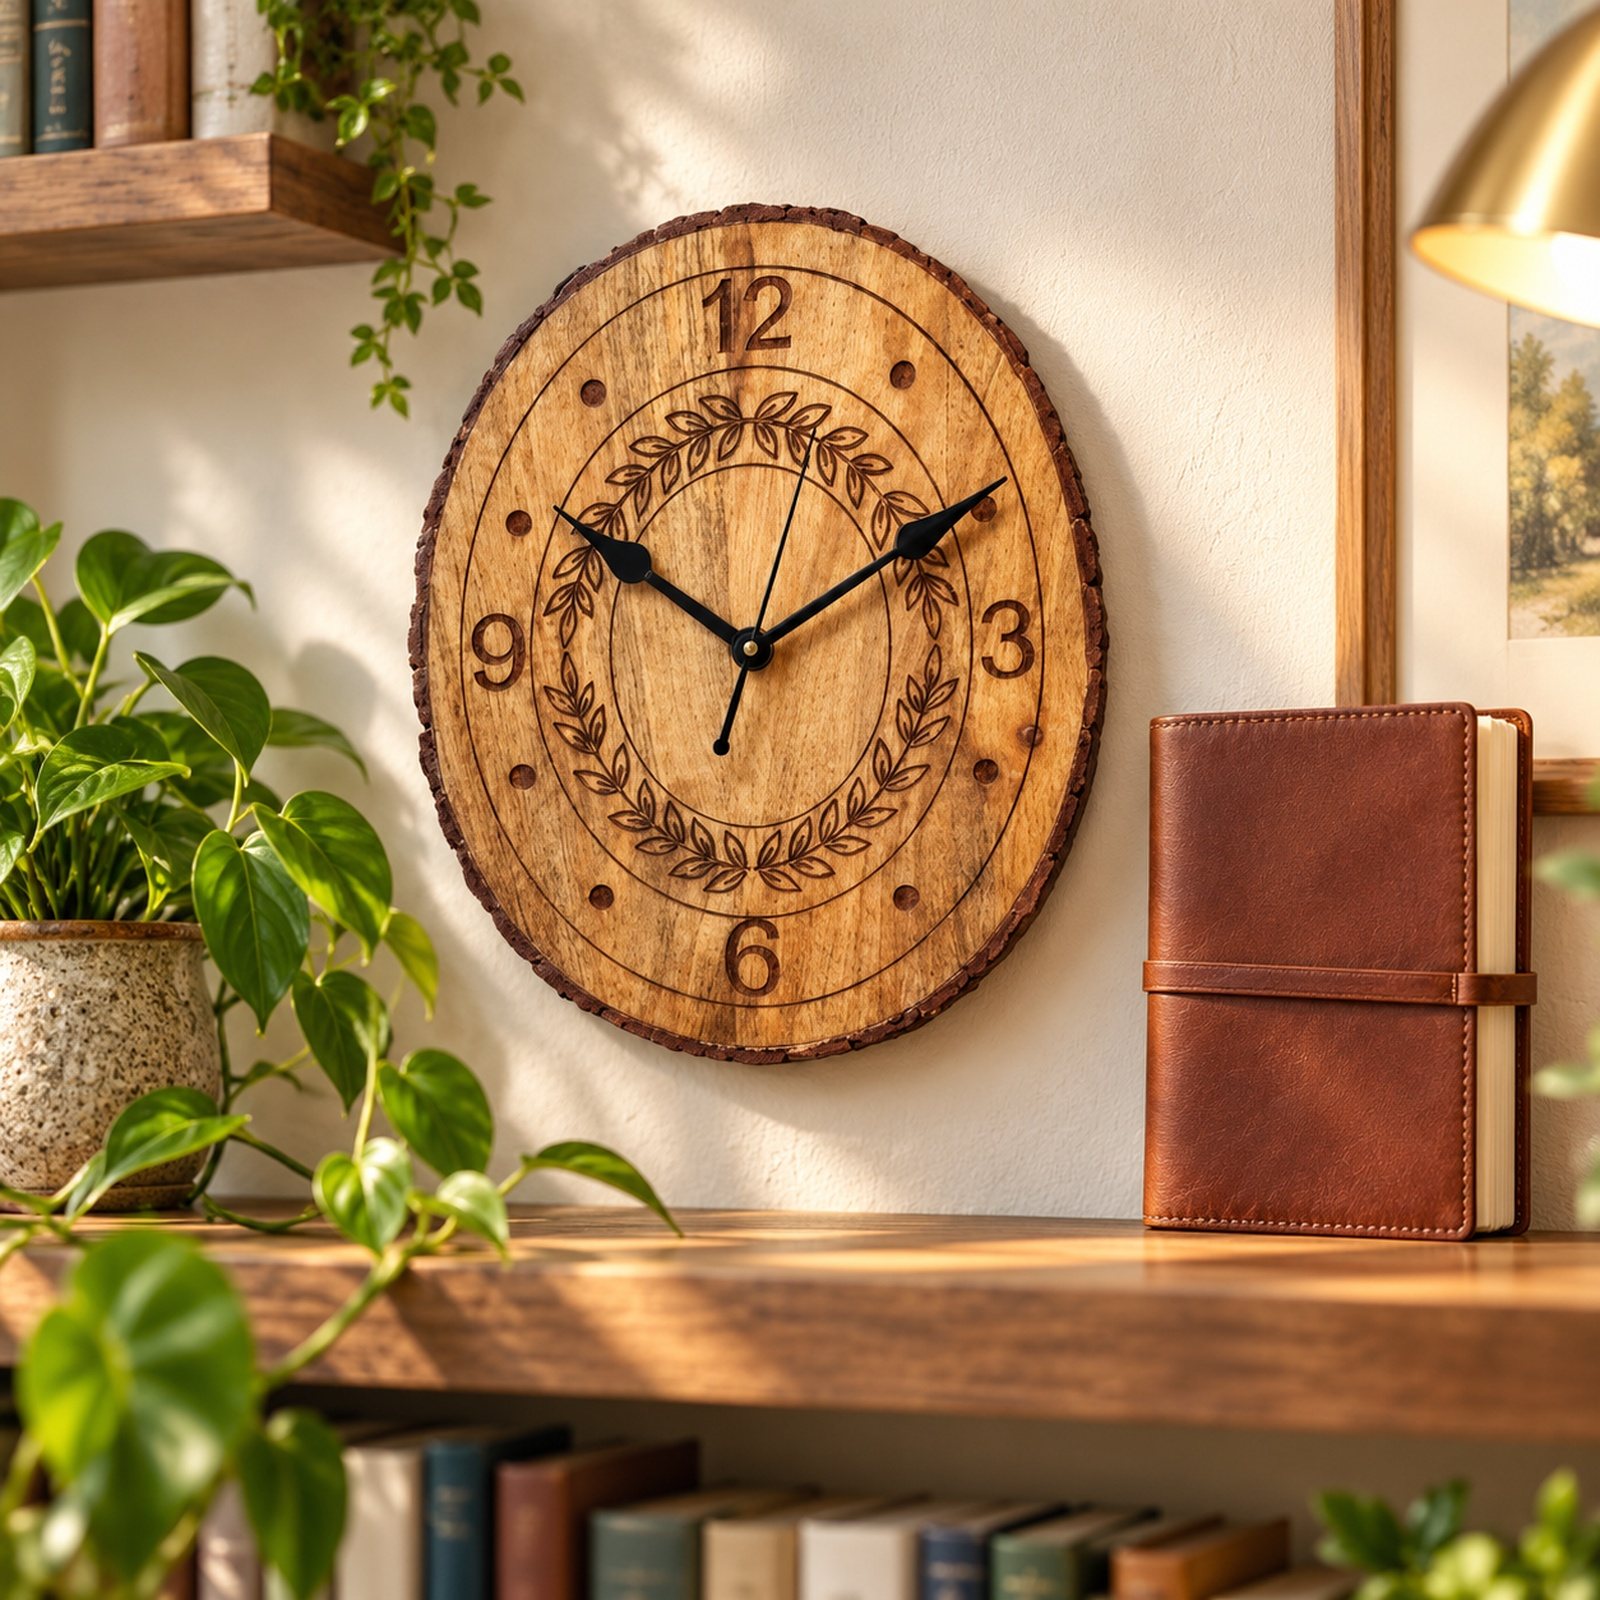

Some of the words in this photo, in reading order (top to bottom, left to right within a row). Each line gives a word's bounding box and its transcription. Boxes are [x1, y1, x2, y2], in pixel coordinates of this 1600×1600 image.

[702, 275, 792, 353] 12
[472, 613, 526, 691] 9
[981, 600, 1035, 679] 3
[725, 918, 780, 997] 6
